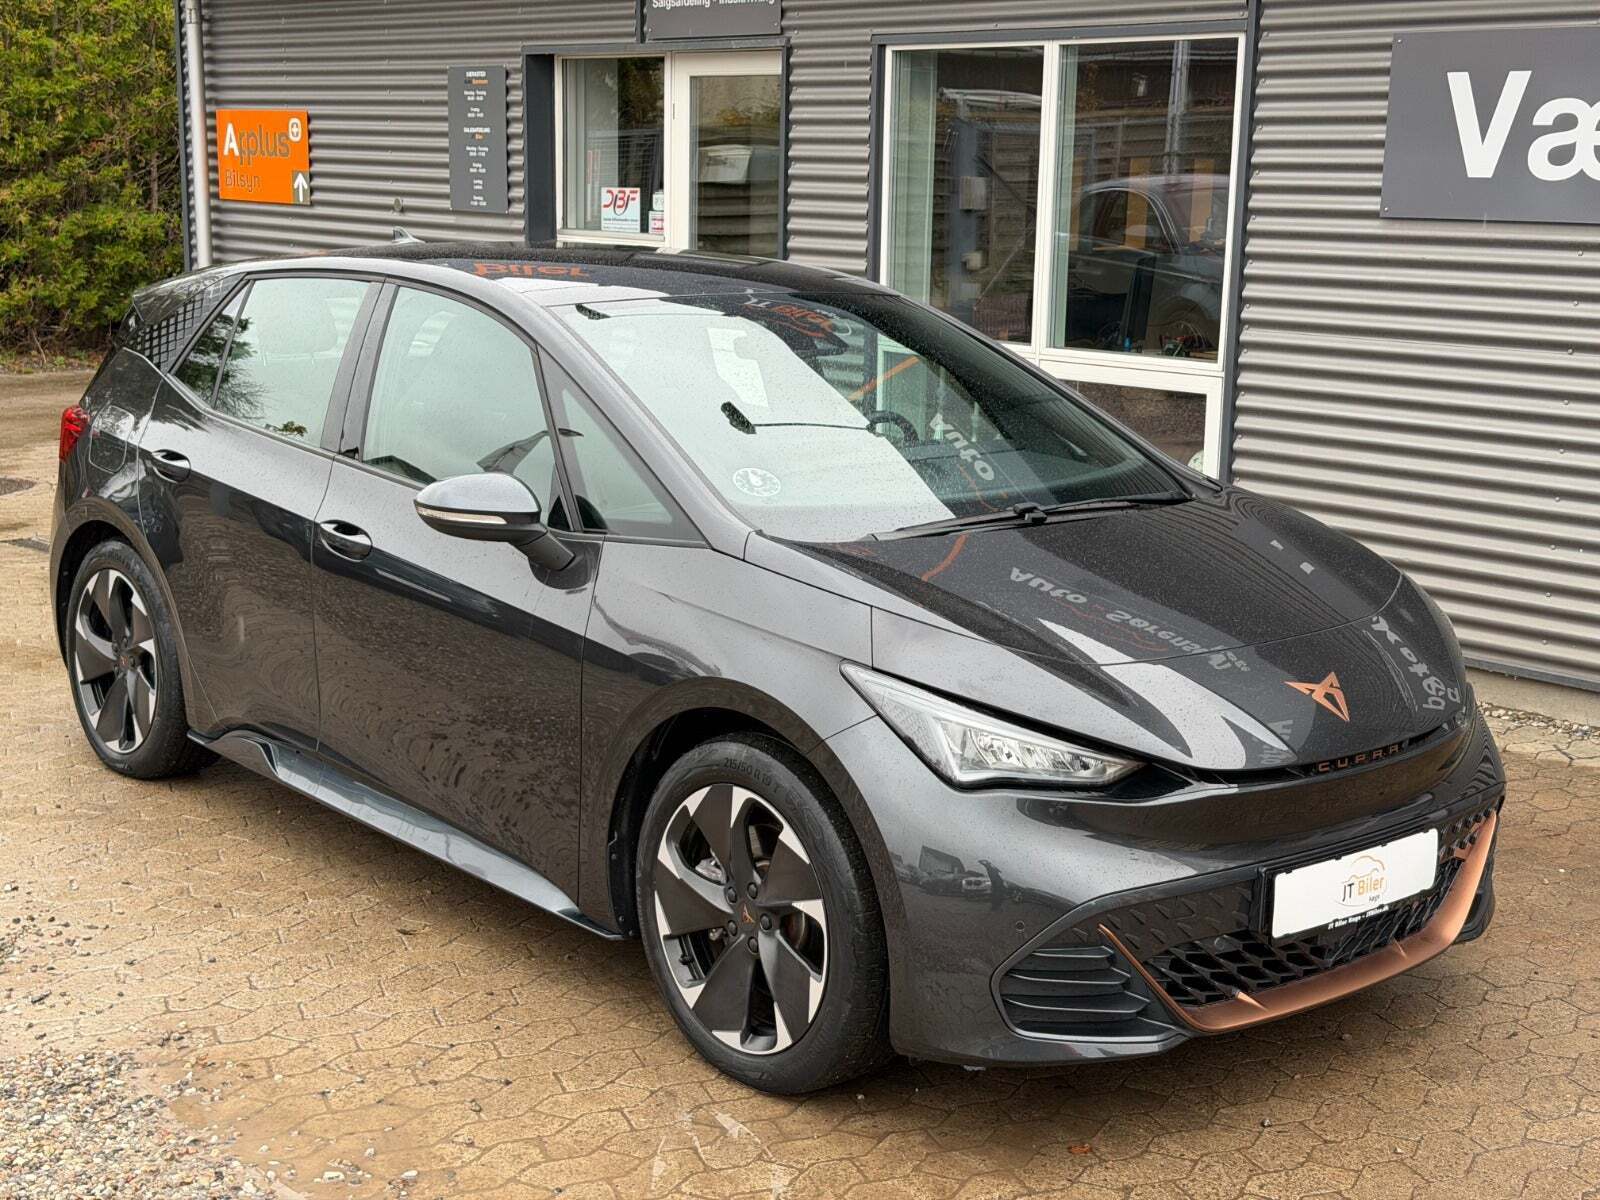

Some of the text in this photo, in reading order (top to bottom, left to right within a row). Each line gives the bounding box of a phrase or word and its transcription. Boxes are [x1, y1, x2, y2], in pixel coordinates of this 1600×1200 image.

[225, 169, 260, 192] Bilsyn
[1318, 744, 1399, 773] CUPRA
[1342, 877, 1385, 902] JT Biler
